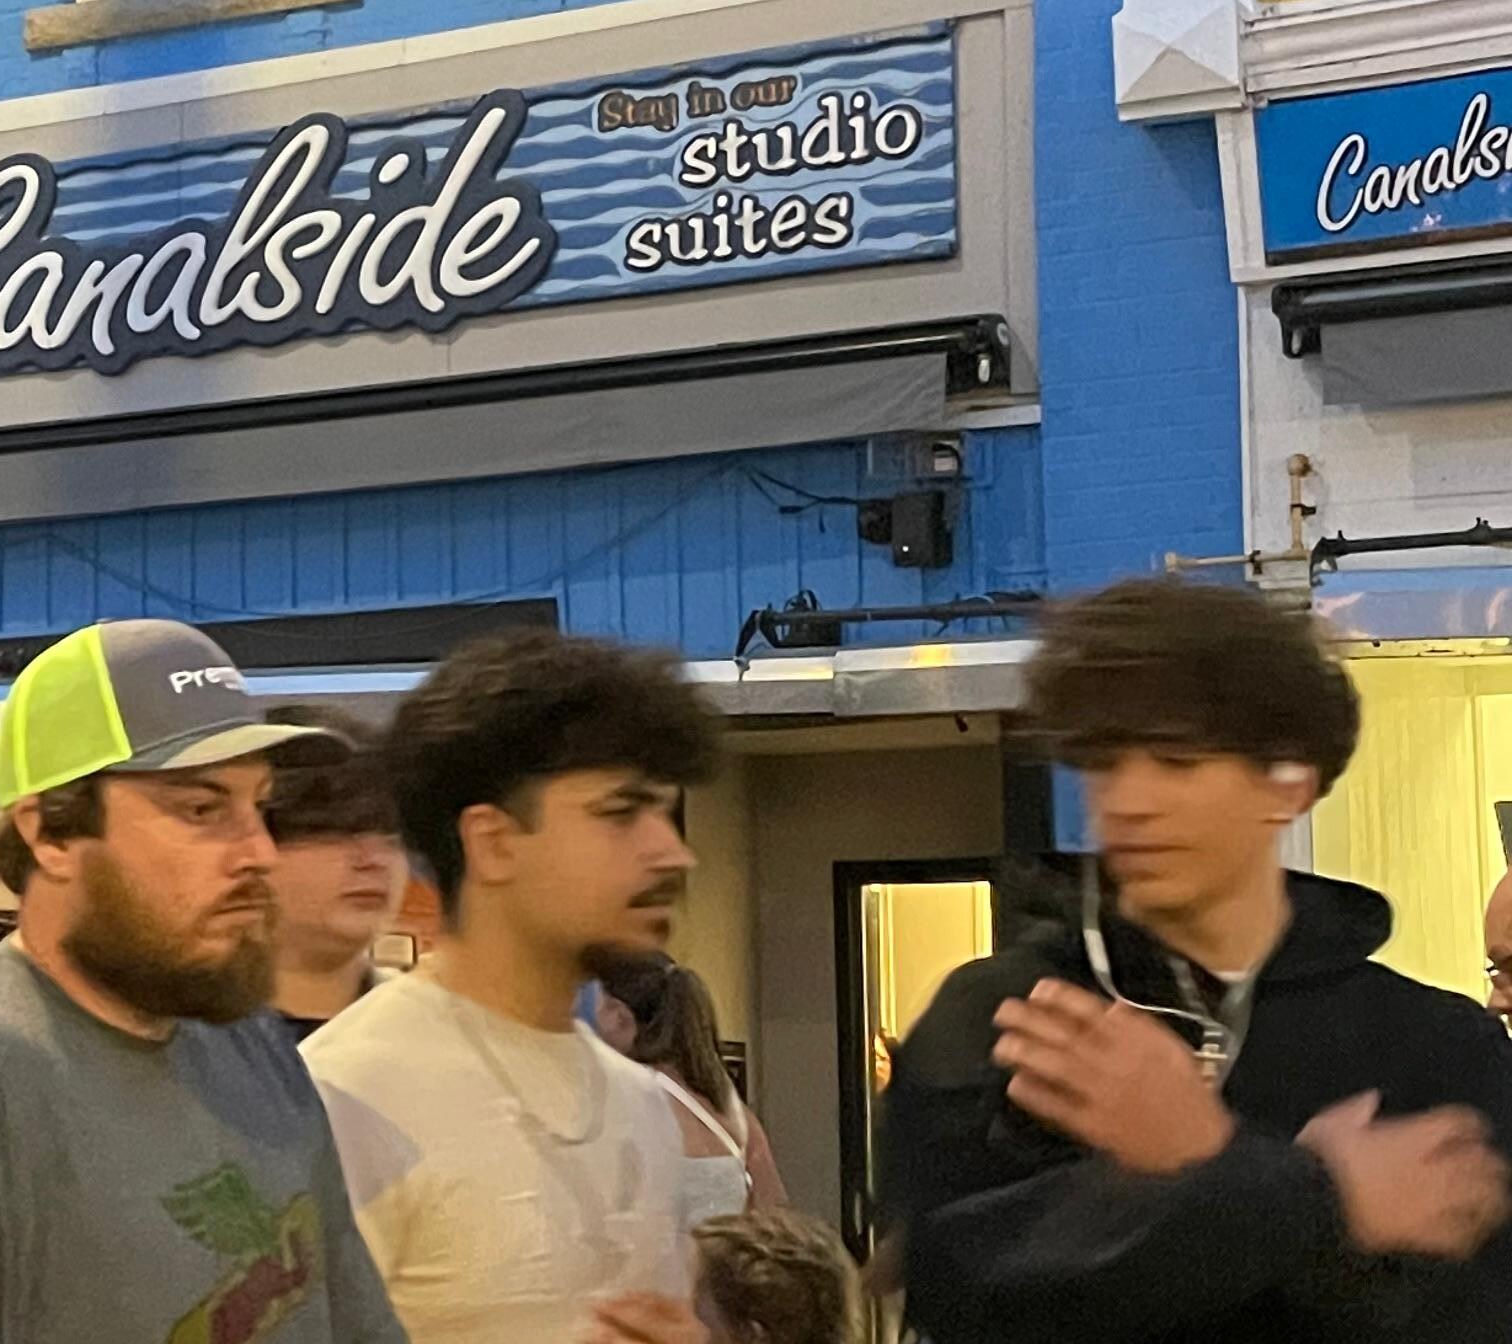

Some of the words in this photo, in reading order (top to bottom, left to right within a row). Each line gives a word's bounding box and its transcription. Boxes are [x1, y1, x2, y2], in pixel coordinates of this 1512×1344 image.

[598, 91, 679, 131] Stay
[688, 82, 724, 116] in
[731, 76, 798, 110] our
[682, 94, 919, 184] studio
[627, 194, 850, 269] suites
